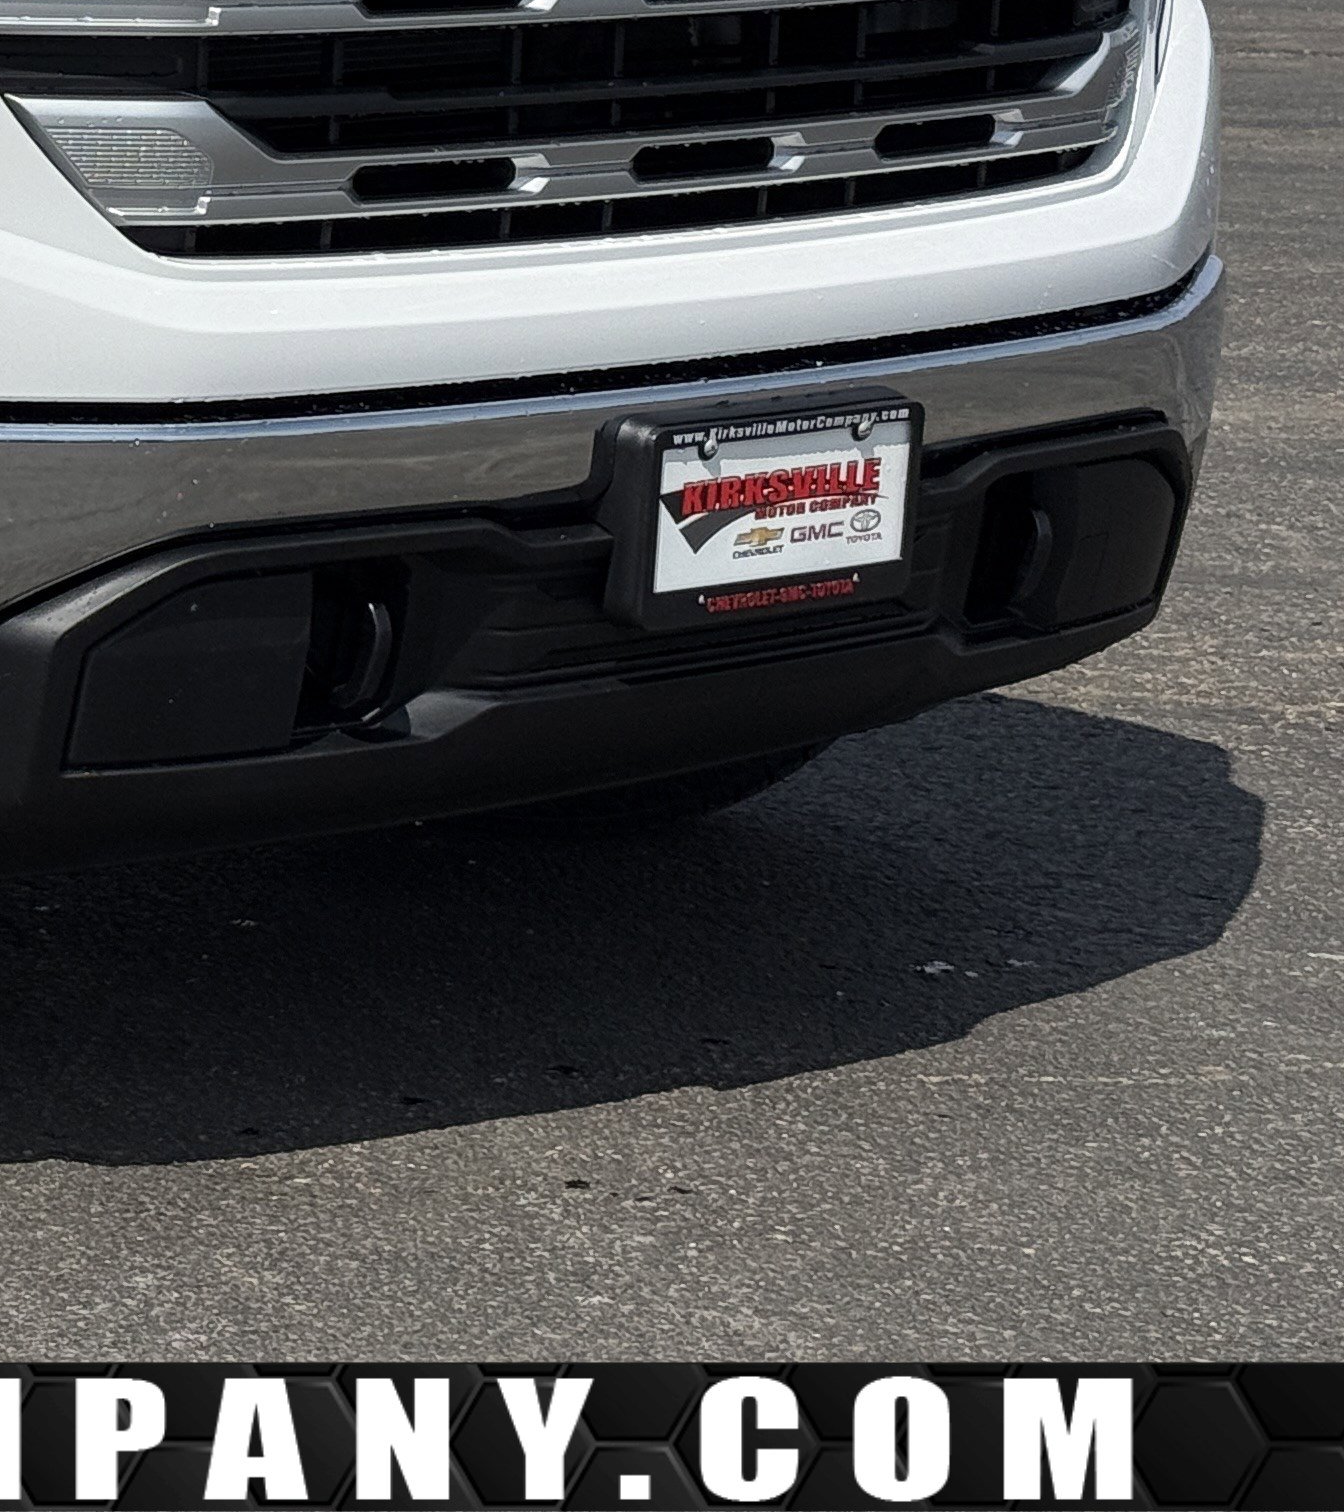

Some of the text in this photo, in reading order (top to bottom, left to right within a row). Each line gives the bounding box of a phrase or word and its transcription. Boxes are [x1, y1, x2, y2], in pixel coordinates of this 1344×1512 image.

[680, 457, 882, 517] KIRKSVILLE
[754, 493, 878, 521] MOTOR COMPANY
[789, 520, 845, 544] GMC
[845, 531, 883, 545] TOYOTA
[732, 544, 784, 560] CHEVROLET
